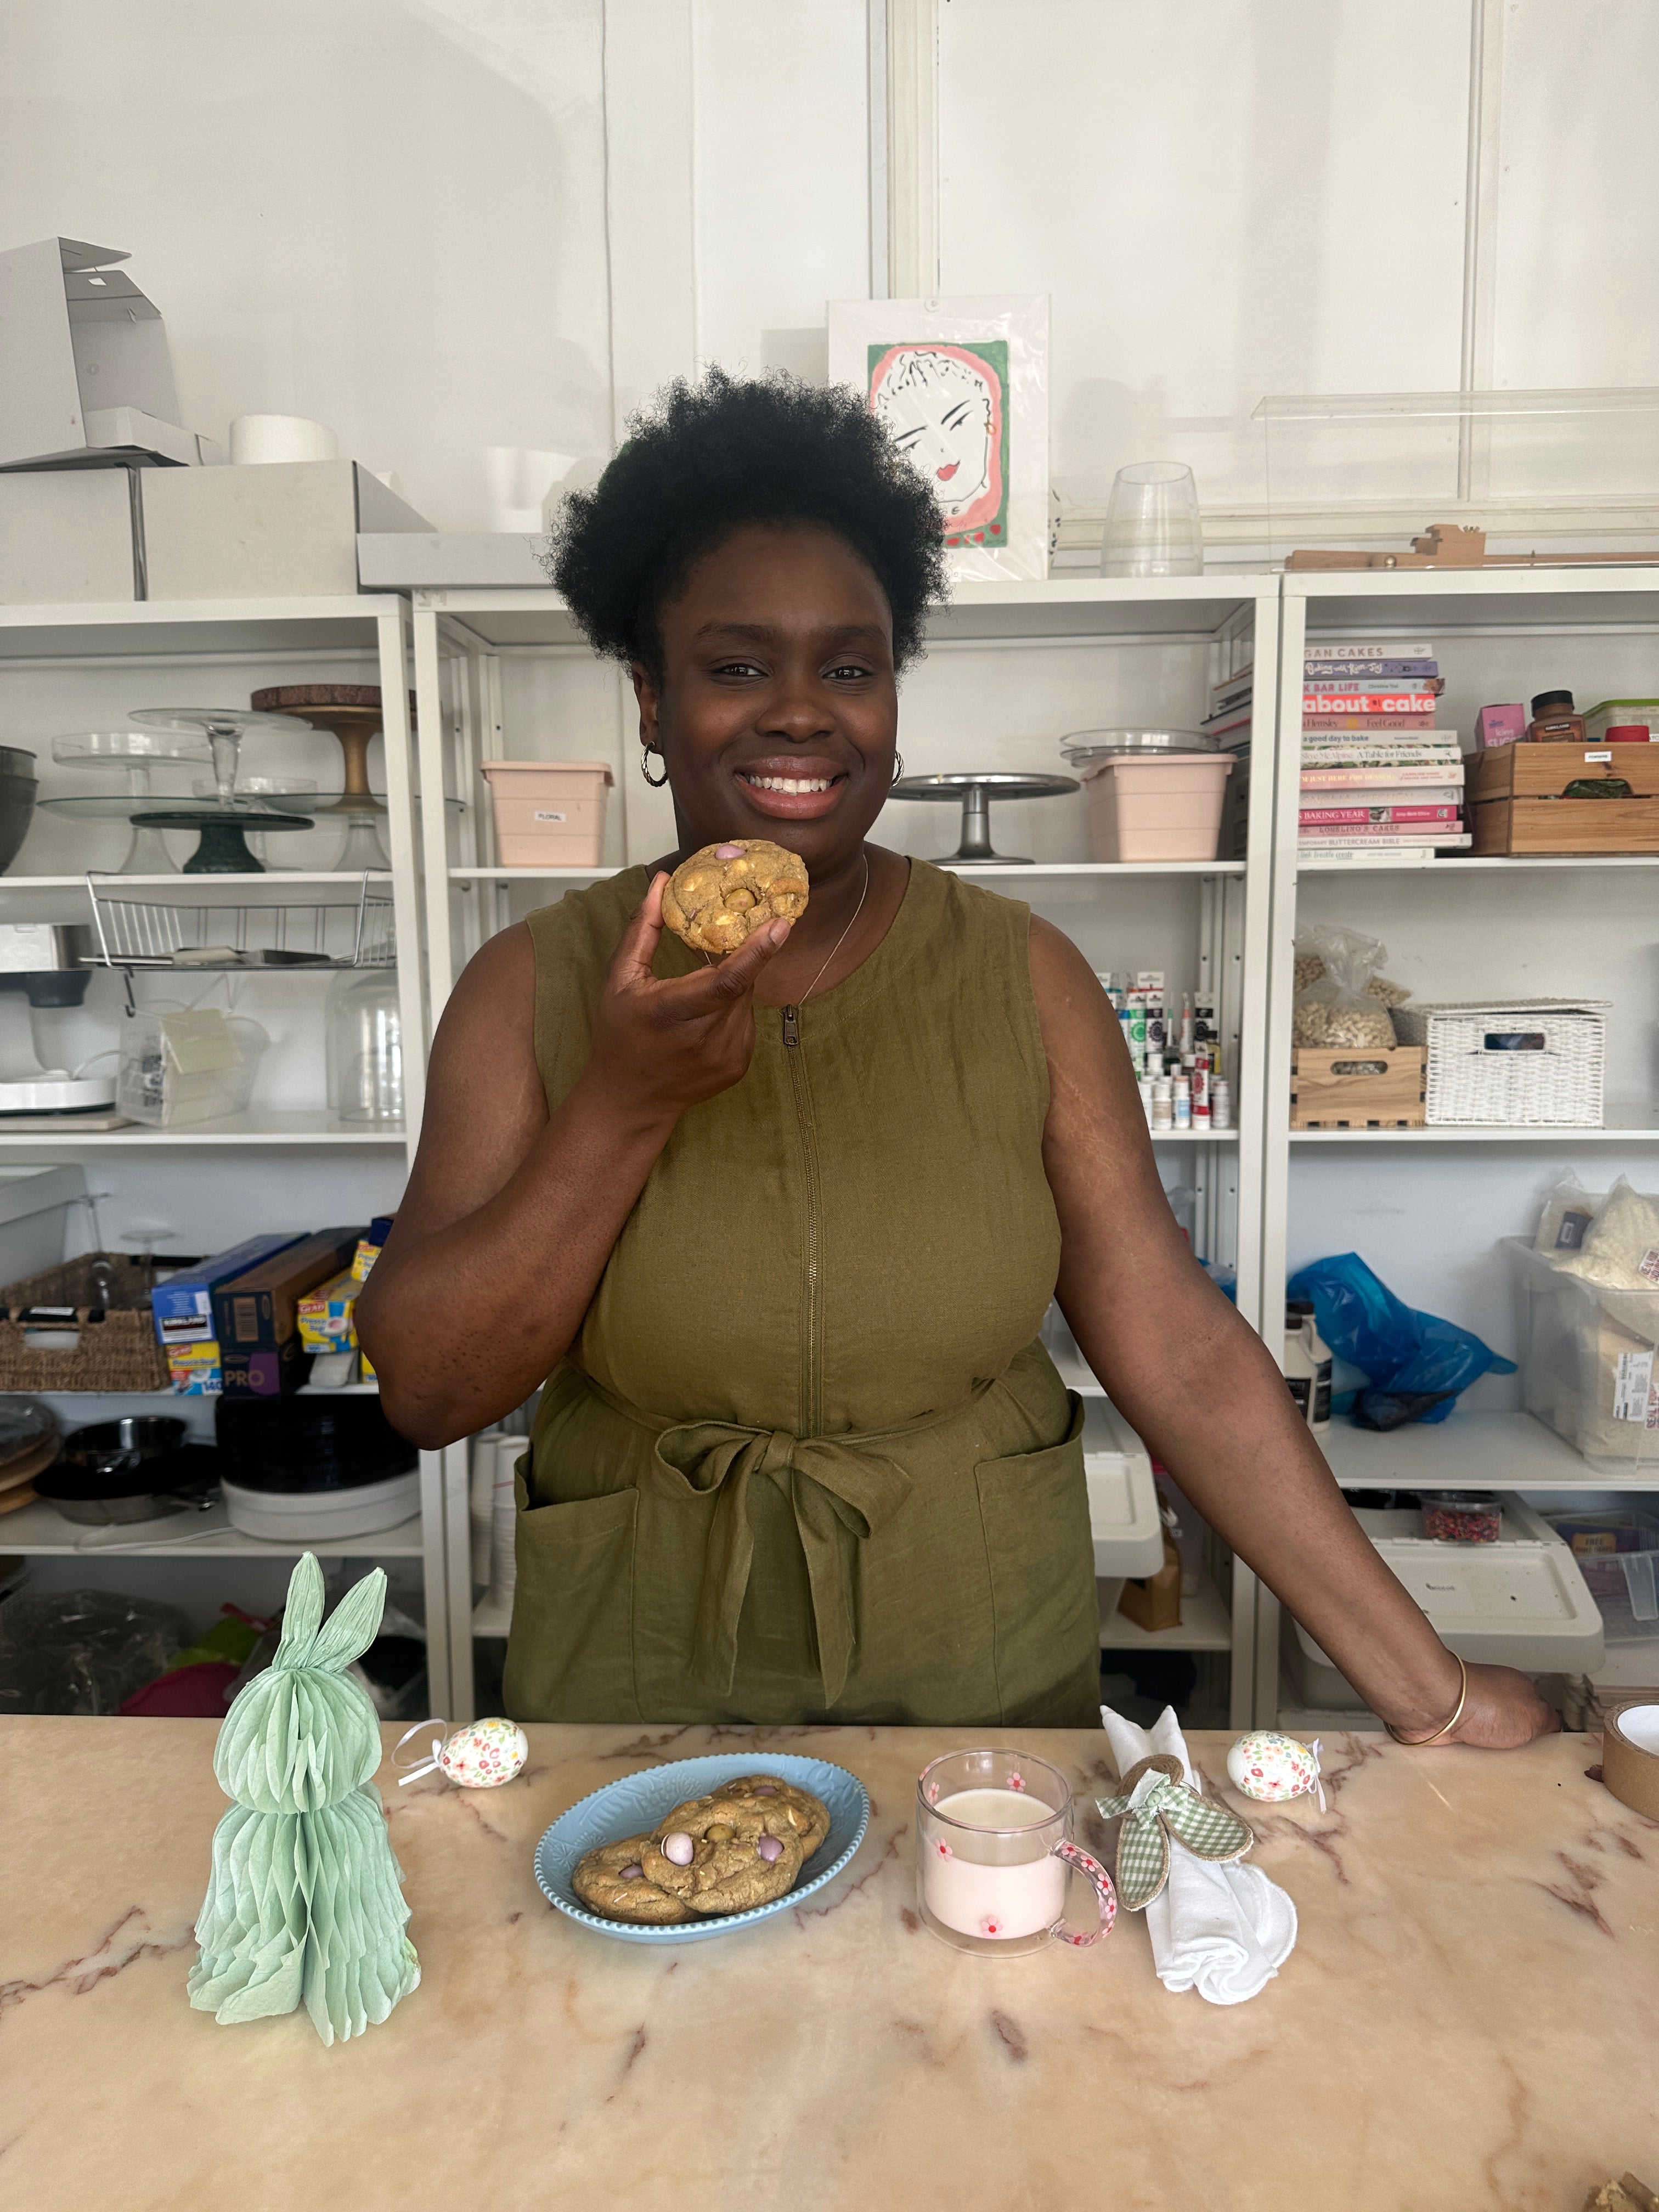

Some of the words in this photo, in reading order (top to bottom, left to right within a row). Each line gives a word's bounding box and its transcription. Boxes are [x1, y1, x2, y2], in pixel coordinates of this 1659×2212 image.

[1338, 647, 1383, 657] CAKES
[1302, 694, 1369, 713] about
[1381, 694, 1435, 712] cake
[1367, 718, 1383, 727] Feel
[1384, 718, 1405, 727] Good
[1304, 810, 1339, 820] BAKING
[1340, 810, 1365, 819] YEAR
[224, 1369, 264, 1387] PRO
